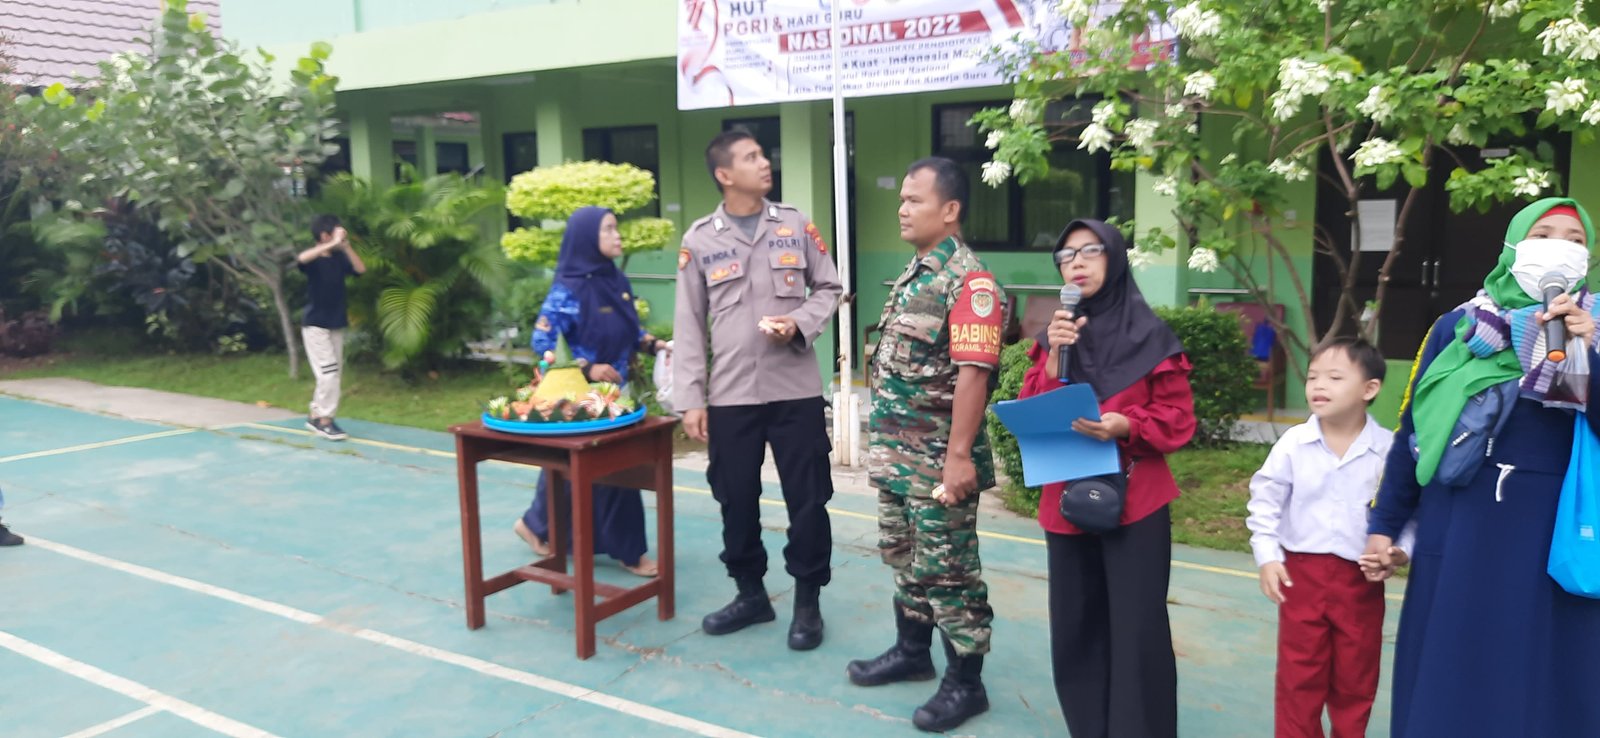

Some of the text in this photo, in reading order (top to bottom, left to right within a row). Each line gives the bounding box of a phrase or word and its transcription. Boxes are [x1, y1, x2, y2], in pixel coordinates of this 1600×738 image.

[730, 0, 768, 17] HUT
[724, 18, 768, 37] PGRI
[772, 16, 782, 32] &
[787, 12, 819, 28] HARI
[904, 14, 961, 39] 2022
[851, 59, 878, 69] Kuat
[889, 52, 948, 65] Indonesia
[963, 71, 987, 80] Guru
[768, 238, 800, 249] POLRI
[951, 341, 981, 352] KORAMIL
